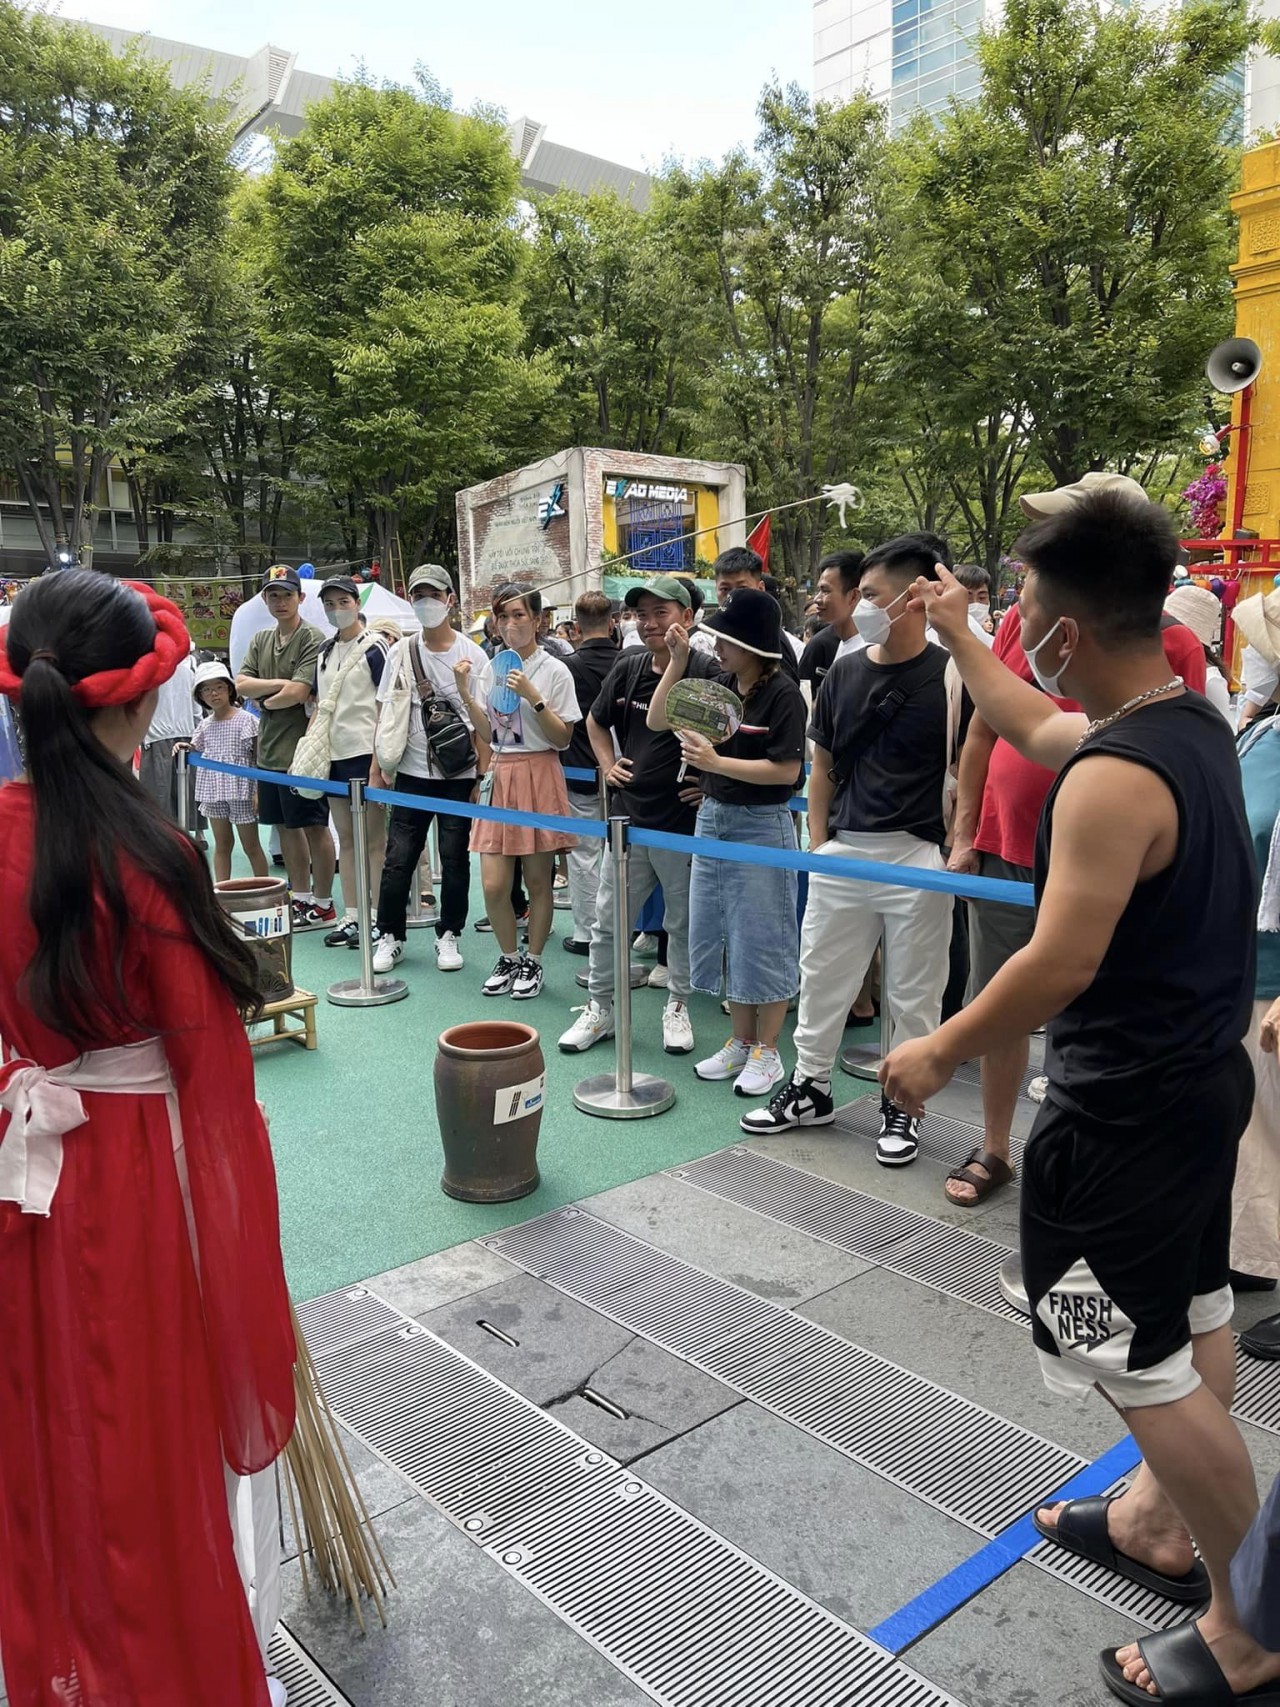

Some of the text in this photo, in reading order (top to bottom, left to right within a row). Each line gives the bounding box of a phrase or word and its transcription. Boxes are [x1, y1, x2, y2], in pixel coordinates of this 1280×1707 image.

[648, 484, 688, 503] MEDIA
[1049, 1292, 1112, 1322] FARSH
[1058, 1314, 1111, 1341] NESS
